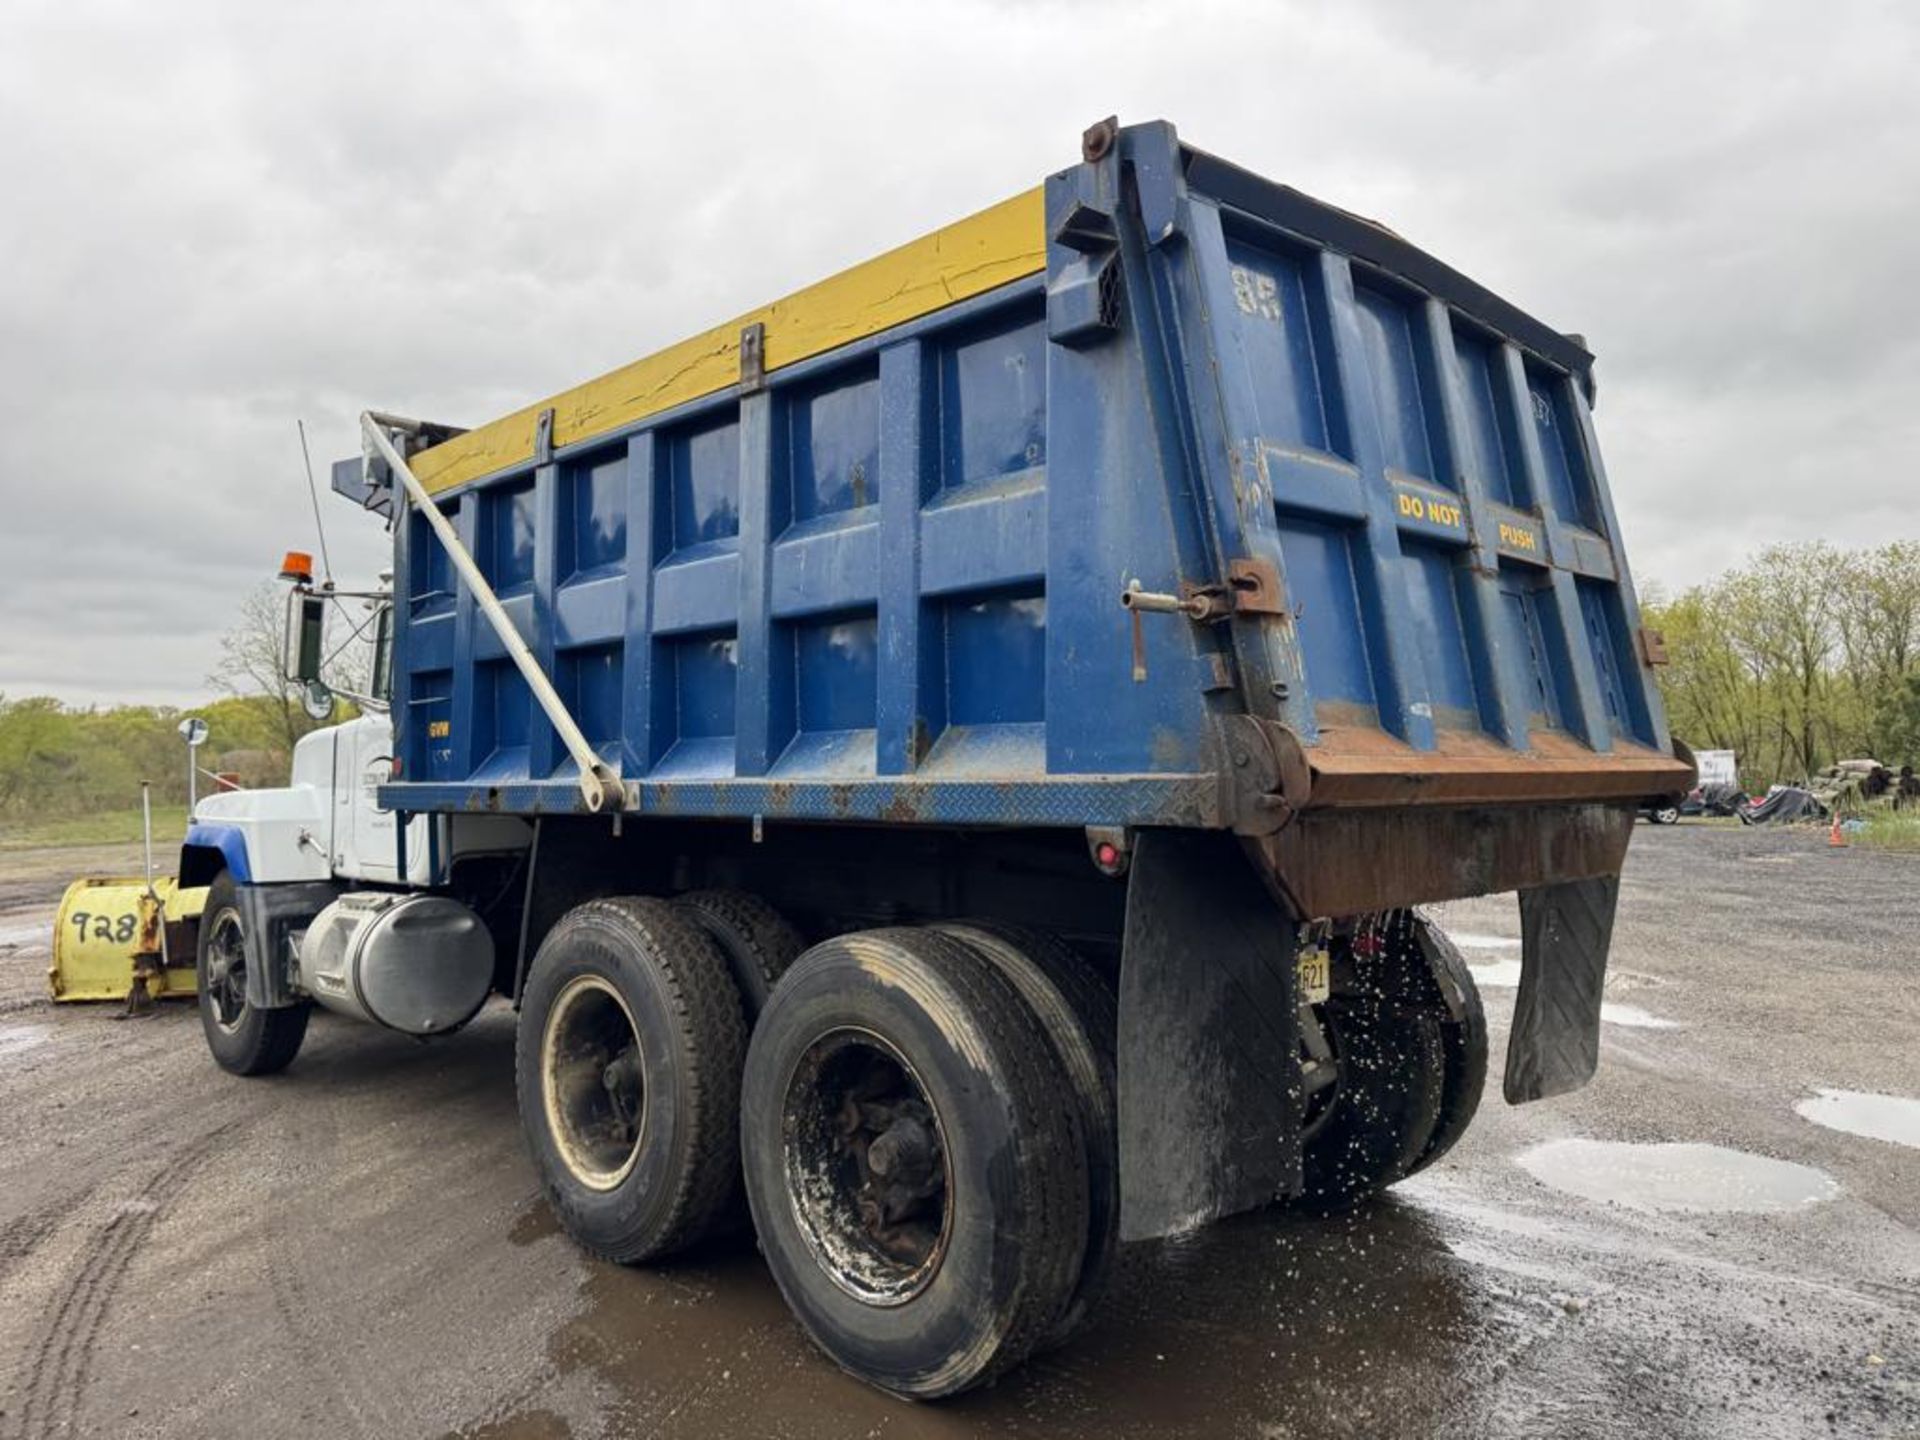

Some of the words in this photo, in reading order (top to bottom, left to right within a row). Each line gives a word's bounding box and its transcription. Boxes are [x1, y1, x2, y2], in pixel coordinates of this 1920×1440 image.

[1399, 494, 1423, 519] DO
[1428, 502, 1460, 528] NOT
[1500, 524, 1535, 551] PUSH
[72, 912, 137, 943] 928
